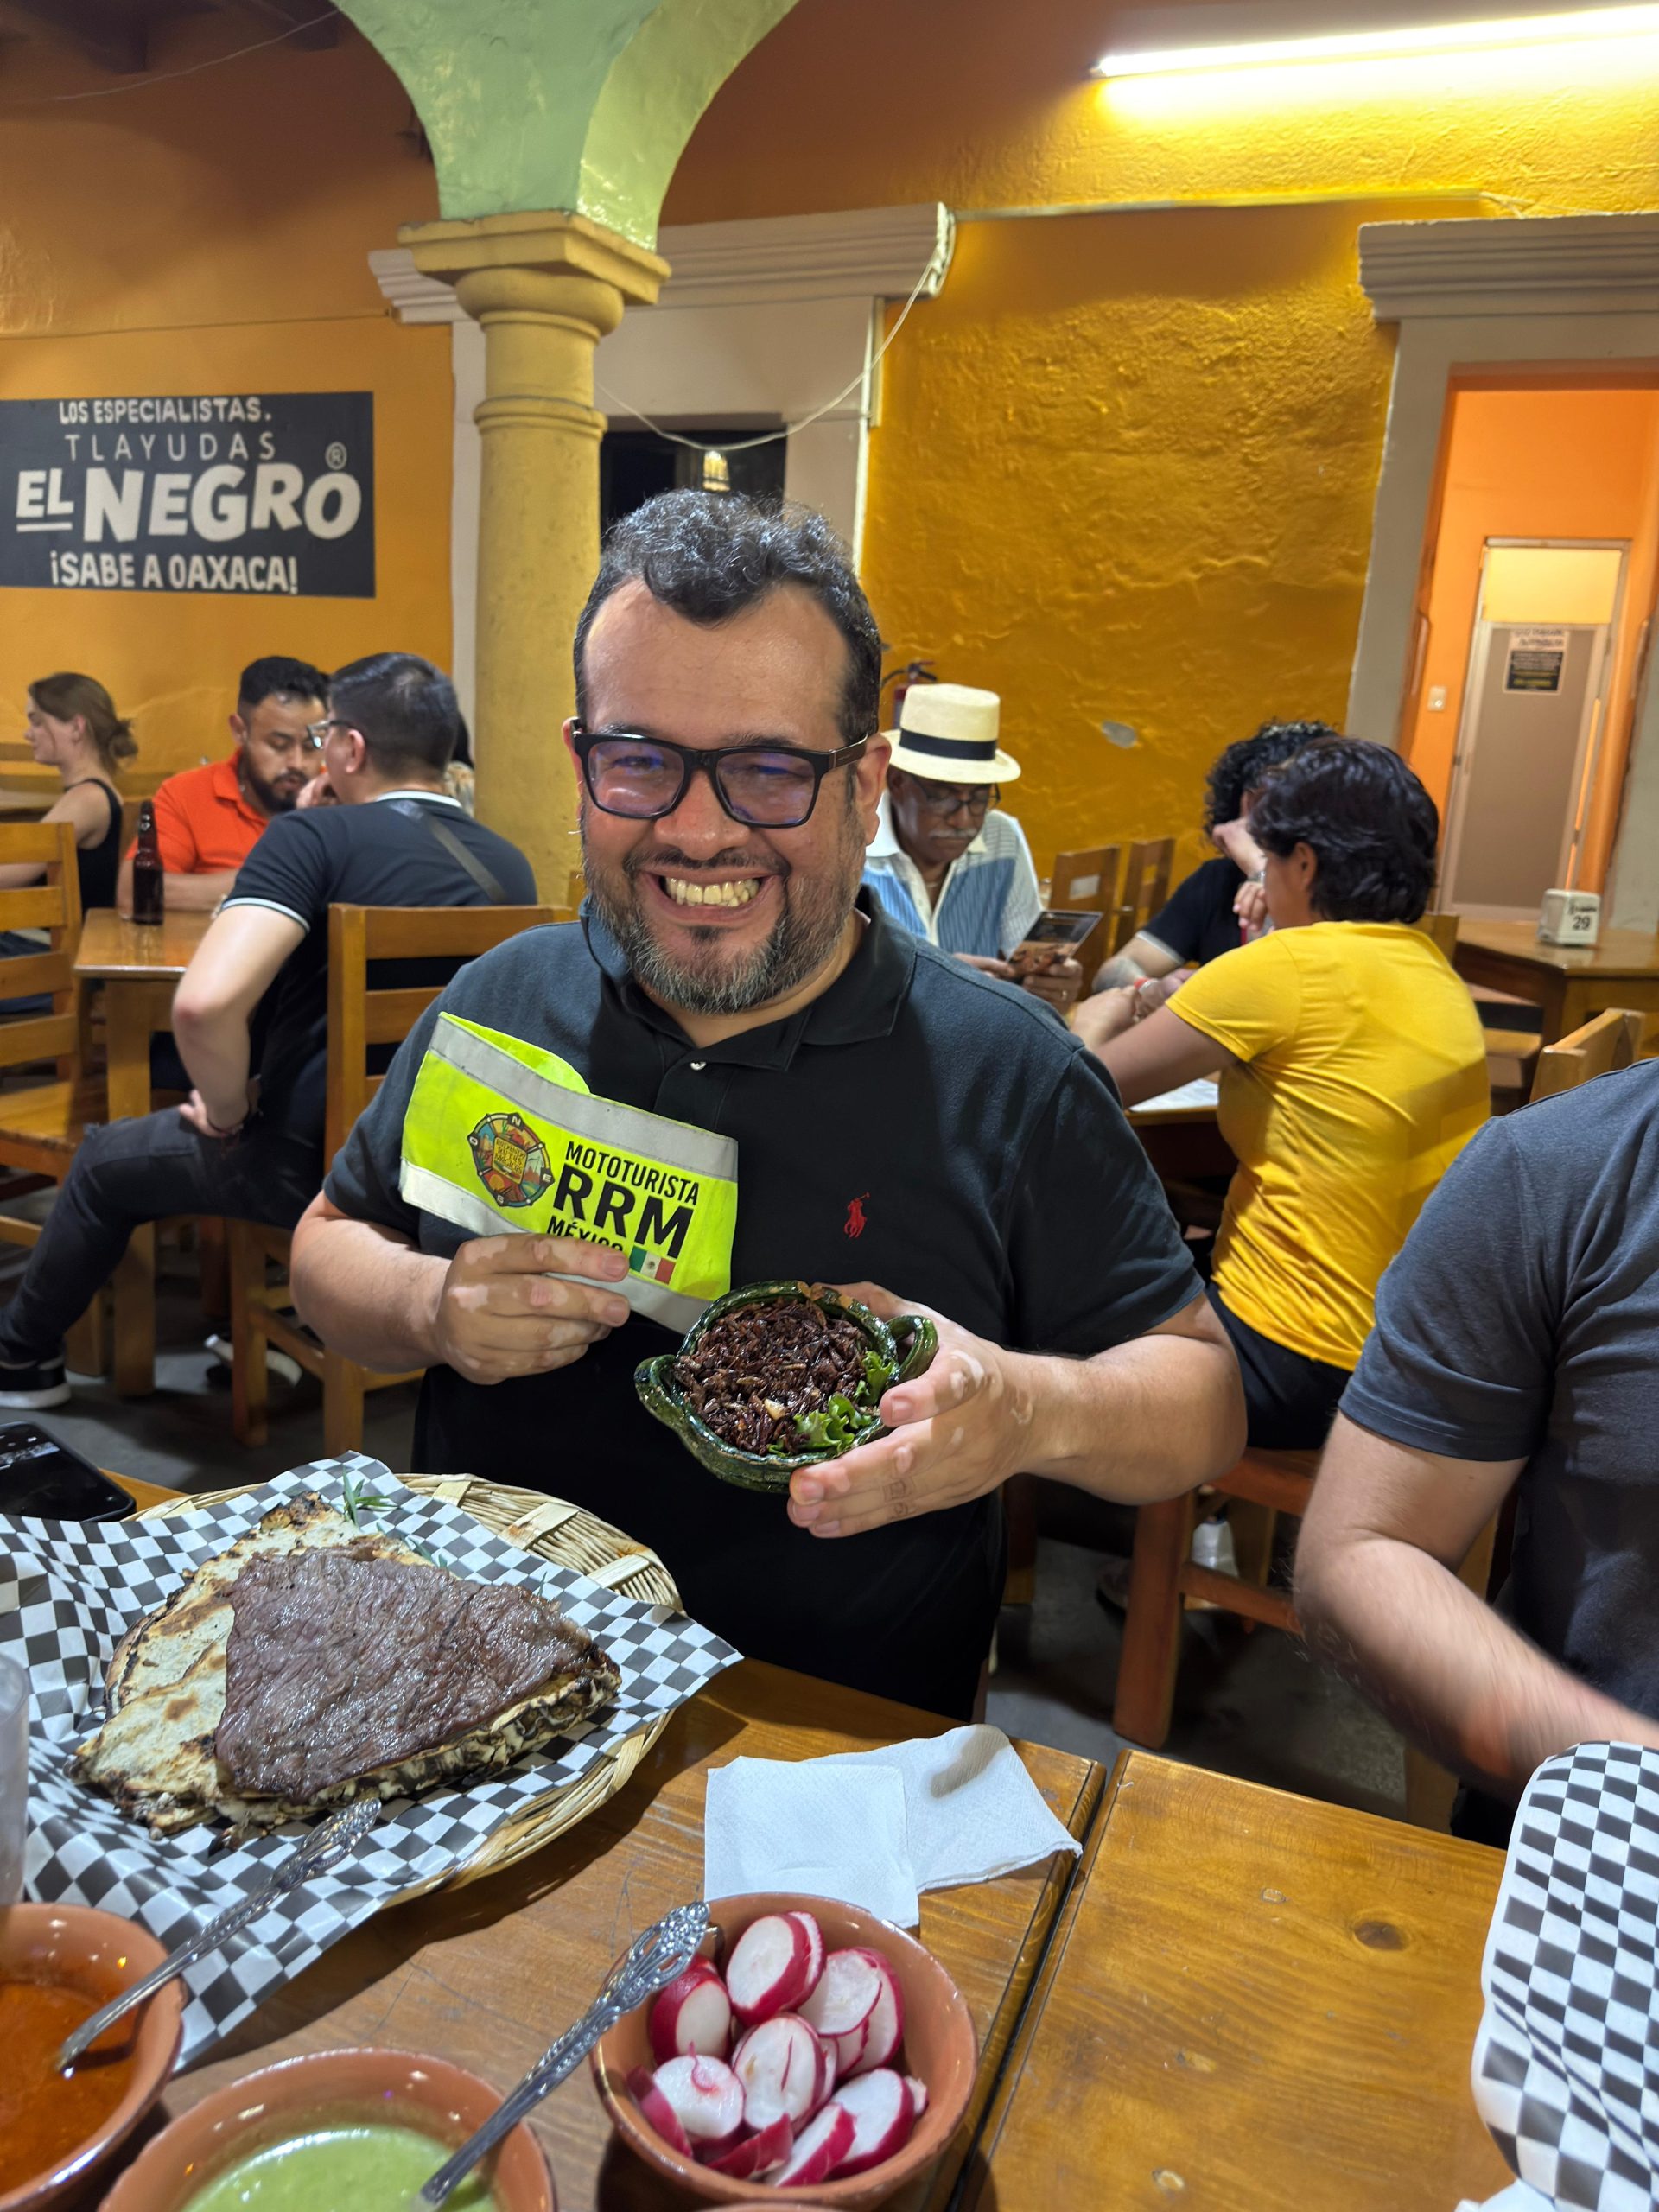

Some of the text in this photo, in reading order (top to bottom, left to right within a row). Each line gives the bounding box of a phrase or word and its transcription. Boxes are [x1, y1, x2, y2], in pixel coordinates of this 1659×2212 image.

[59, 397, 271, 424] LOS ESPECIALISTAS.
[65, 431, 276, 462] TLAYUDAS
[16, 463, 362, 543] EL NEGRO
[50, 550, 298, 594] ¡SABE A OAXACA!
[1573, 915, 1591, 931] 29
[512, 1116, 522, 1126] N
[565, 1141, 700, 1206] MOTOTURISTA
[553, 1163, 694, 1259] RRM
